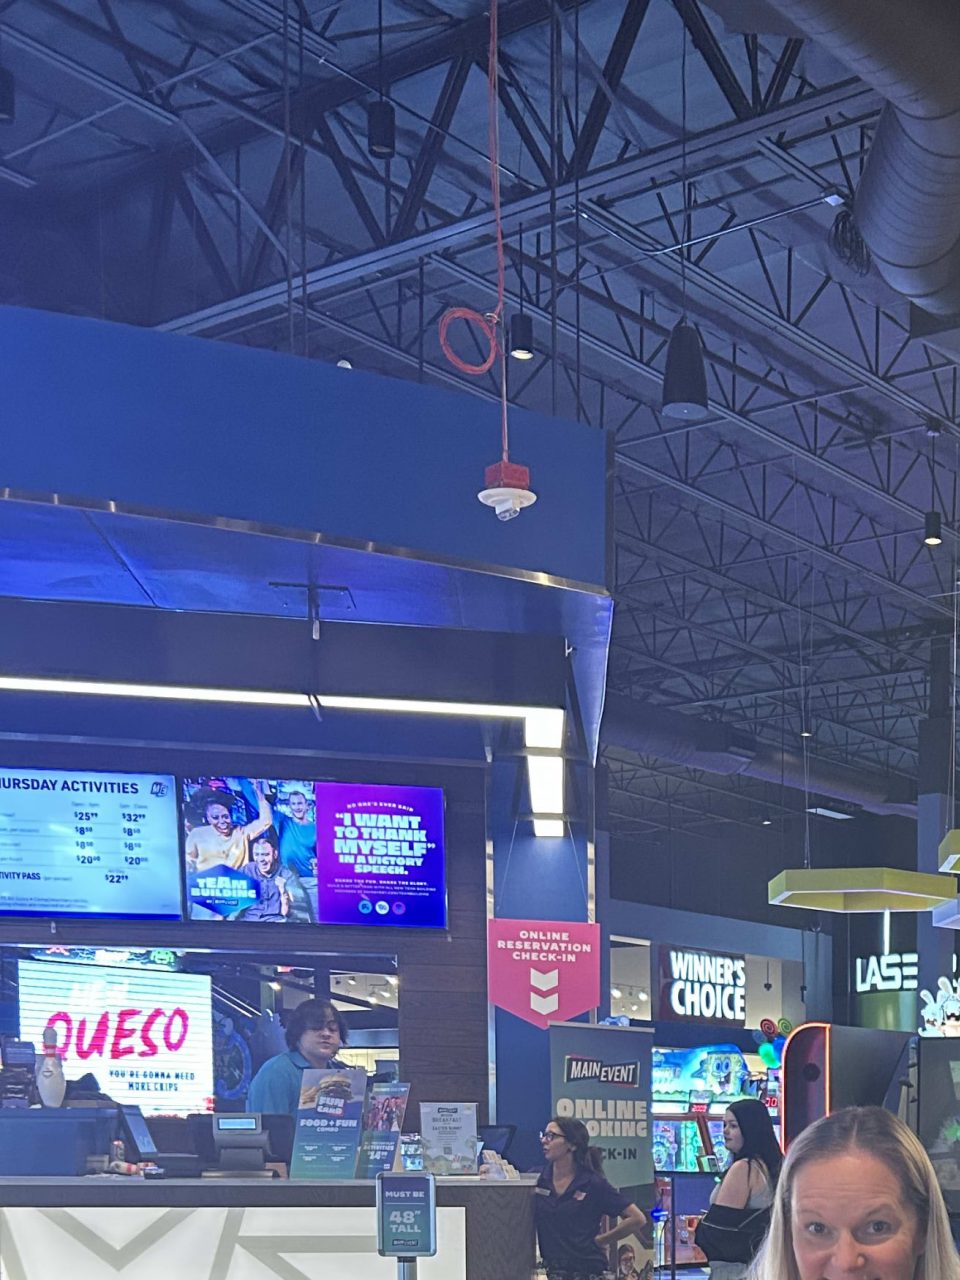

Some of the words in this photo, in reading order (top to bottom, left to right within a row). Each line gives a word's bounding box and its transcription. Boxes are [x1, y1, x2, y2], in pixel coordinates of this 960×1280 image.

[0, 777, 58, 791] URSDAY
[61, 780, 139, 794] ACTIVITIES
[354, 813, 421, 829] WANT
[334, 826, 359, 838] TO
[361, 828, 427, 841] THANK
[339, 854, 355, 863] IN
[356, 855, 367, 864] A
[368, 856, 424, 866] VICTORY
[22, 872, 41, 880] PASS
[354, 865, 409, 875] SPEECH.
[196, 876, 248, 889] TEAM
[191, 887, 256, 898] BUILDING
[519, 930, 570, 941] ONLINE
[497, 940, 592, 953] RESERVATION
[512, 952, 576, 962] CHECK-IN
[670, 951, 746, 987] WINNER'S
[856, 953, 957, 992] LASE
[671, 980, 746, 1020] CHOICE
[43, 1006, 189, 1061] QUESO
[143, 1071, 171, 1079] GONNA
[174, 1072, 195, 1080] NEED
[570, 1060, 601, 1079] MAIN
[600, 1065, 636, 1082] EVENT
[128, 1081, 151, 1091] MORE
[318, 1096, 345, 1107] FUN
[556, 1098, 647, 1120] ONLINE
[300, 1119, 328, 1127] FOOD
[335, 1119, 358, 1127] FUN
[580, 1120, 648, 1137] OKING
[390, 1225, 421, 1233] TALL
